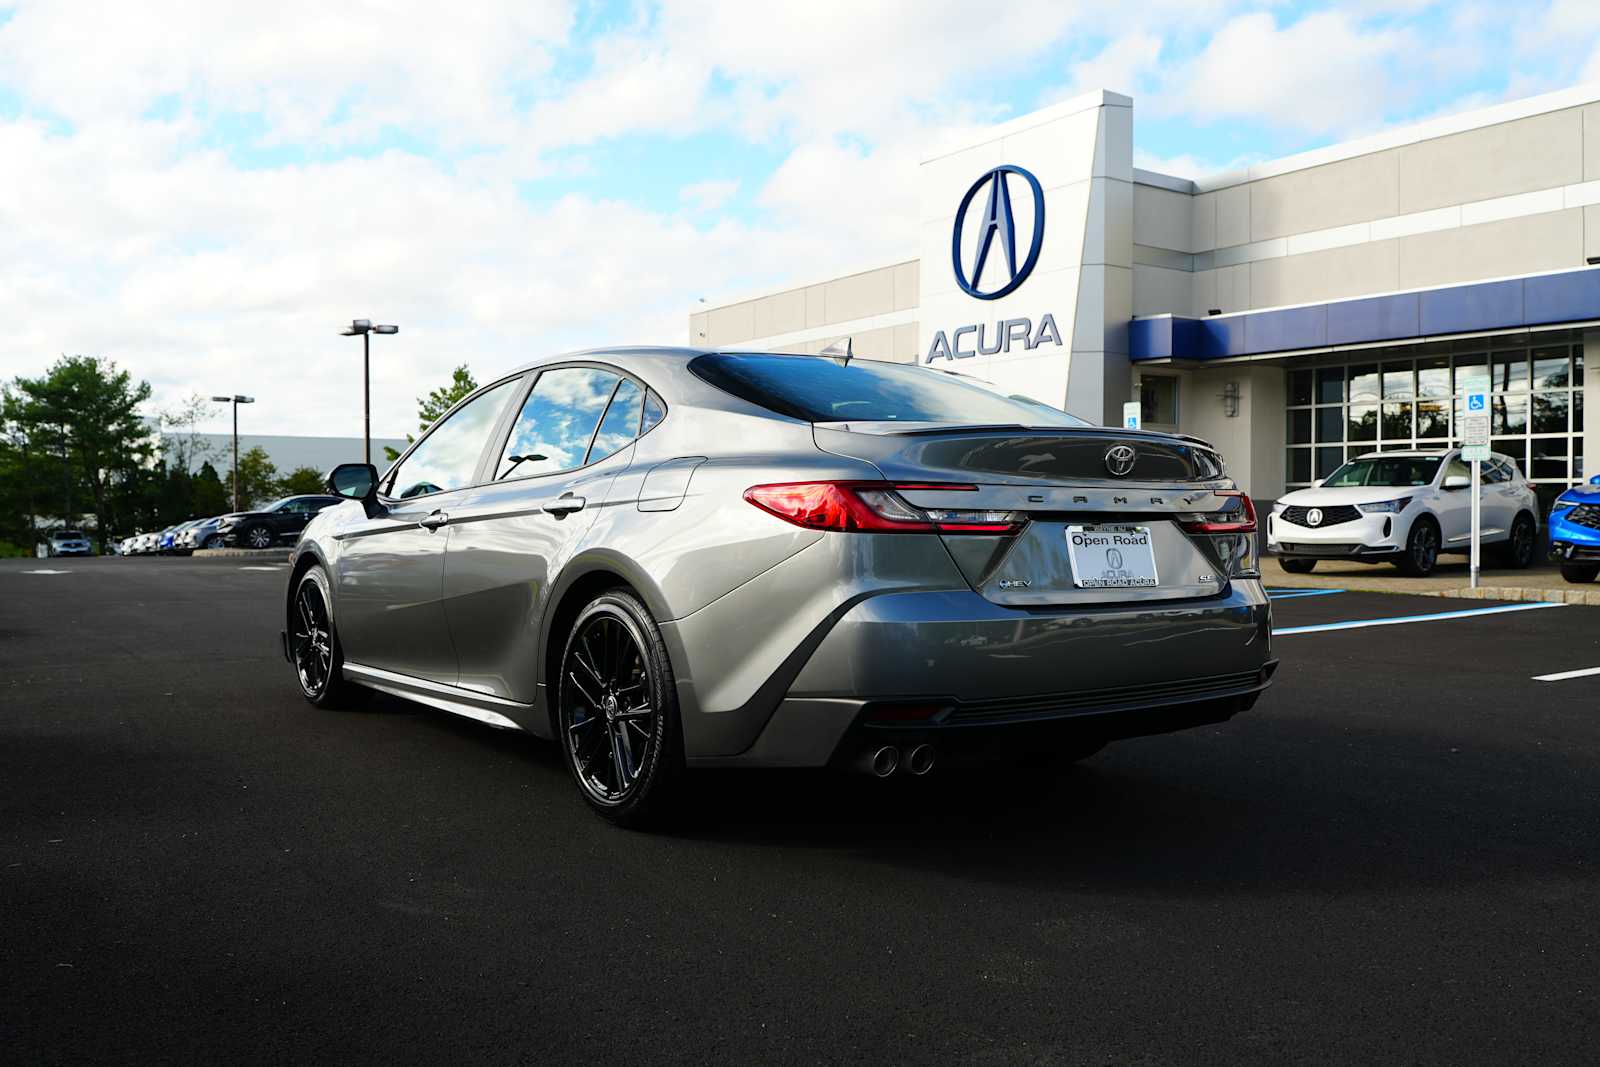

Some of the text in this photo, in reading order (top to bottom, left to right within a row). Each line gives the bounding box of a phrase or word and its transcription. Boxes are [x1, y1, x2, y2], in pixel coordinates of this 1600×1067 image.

[925, 313, 1063, 364] ACURA
[1028, 495, 1195, 506] CAMRY
[1072, 535, 1147, 547] Open Road
